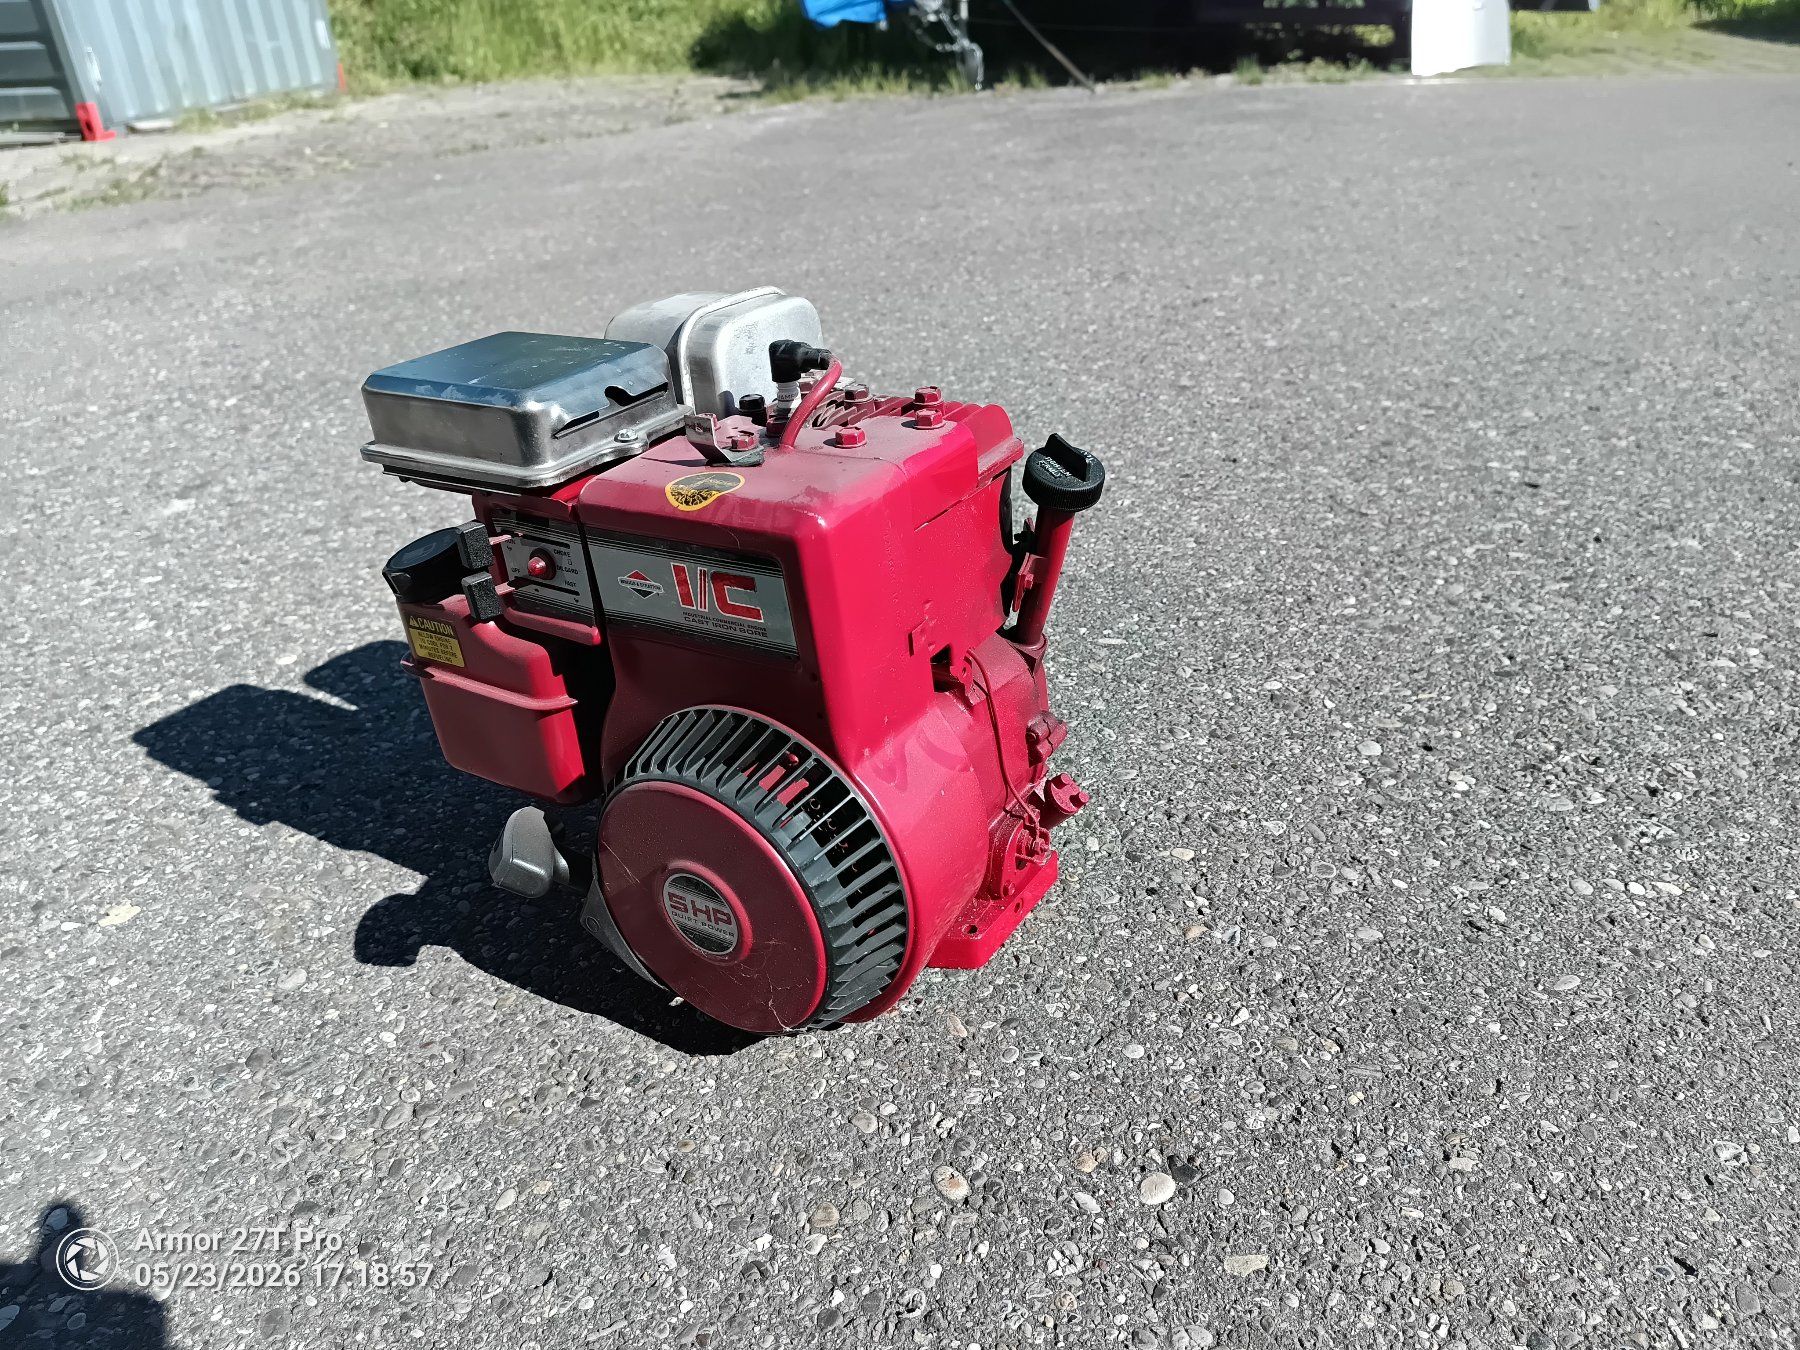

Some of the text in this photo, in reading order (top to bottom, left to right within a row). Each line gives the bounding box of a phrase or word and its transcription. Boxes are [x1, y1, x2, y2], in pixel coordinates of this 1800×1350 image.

[553, 548, 571, 557] CHOKE
[417, 618, 454, 636] CAUTION
[684, 616, 768, 638] CAST IRON BORE
[672, 910, 735, 937] QUIET POWER
